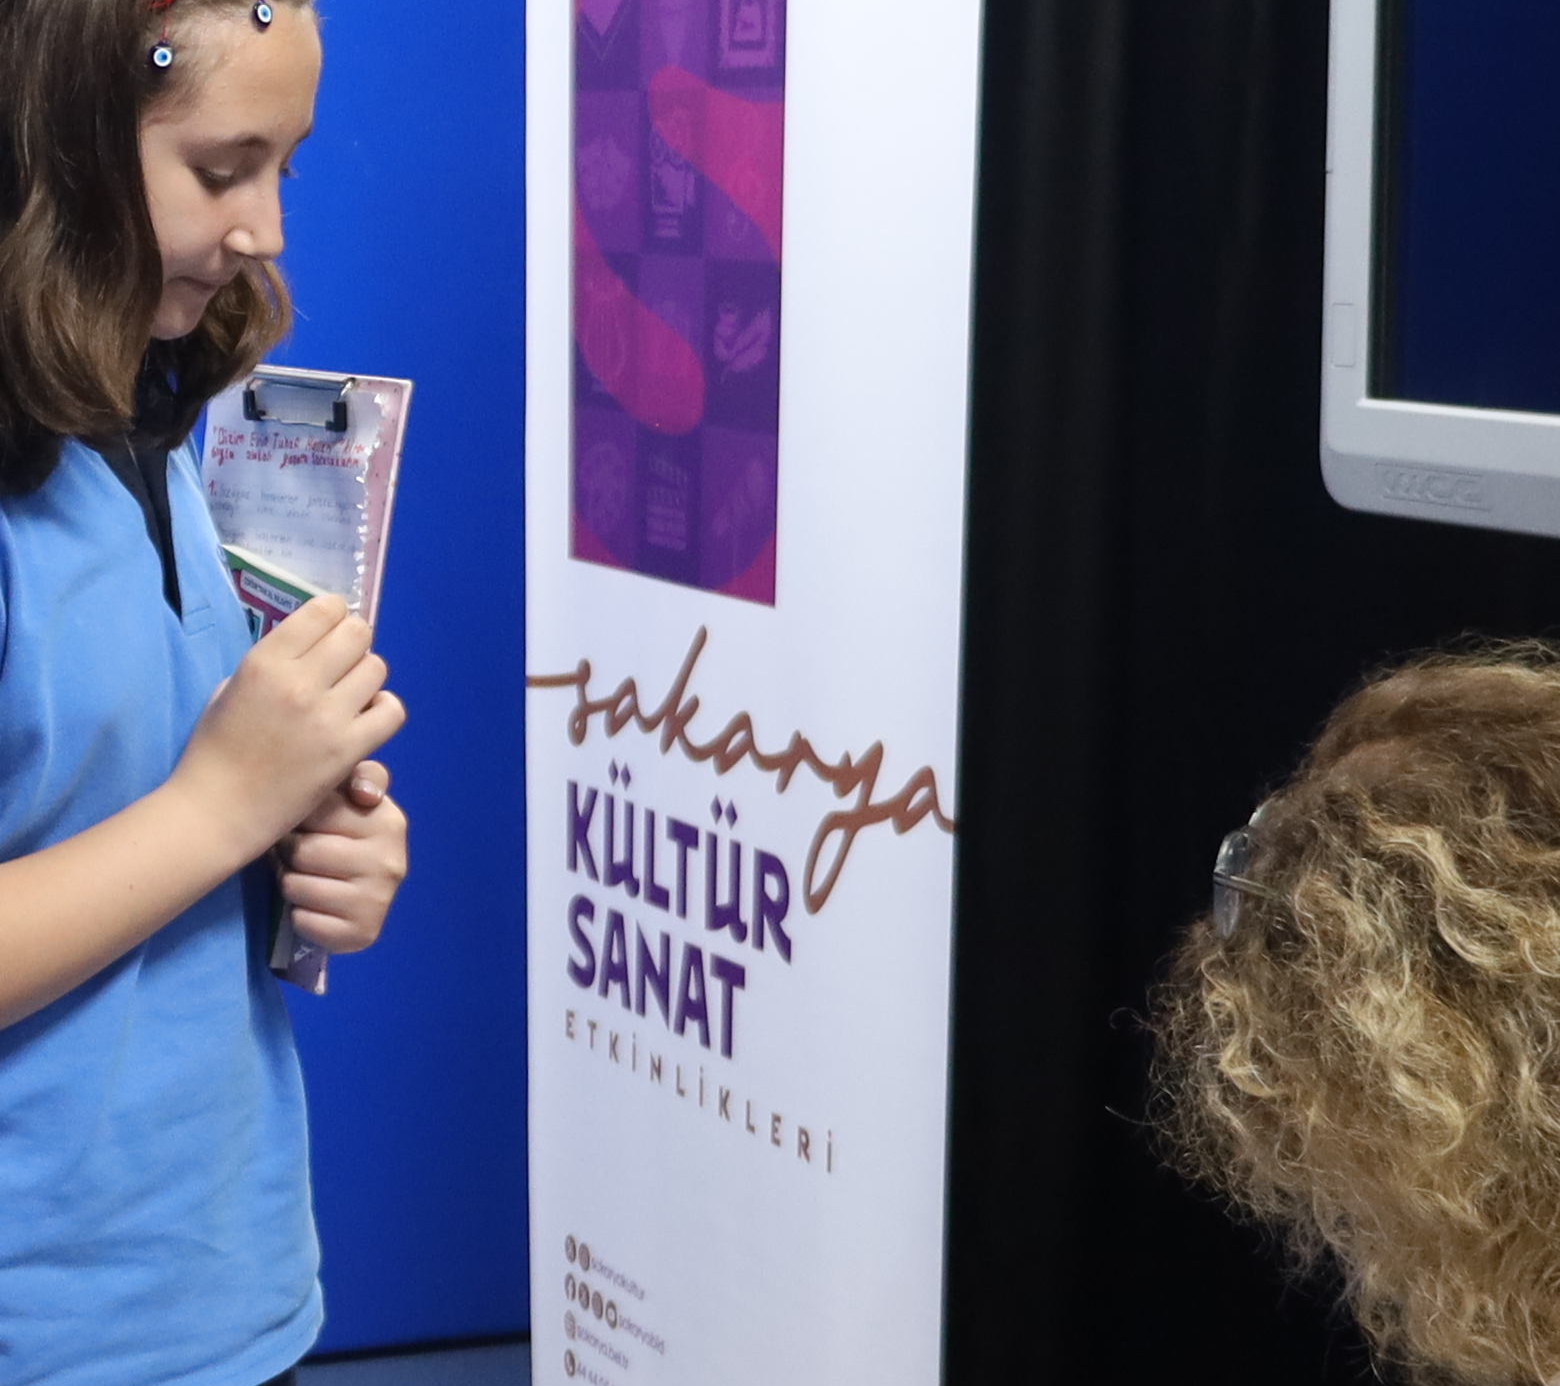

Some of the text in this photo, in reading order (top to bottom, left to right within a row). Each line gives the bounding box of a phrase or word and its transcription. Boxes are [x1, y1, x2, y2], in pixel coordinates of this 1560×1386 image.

[526, 624, 957, 915] sakarya
[566, 757, 792, 966] KÜLTÜR
[566, 893, 747, 1060] SANAT
[565, 1009, 833, 1173] ETKİNLİKLERİ
